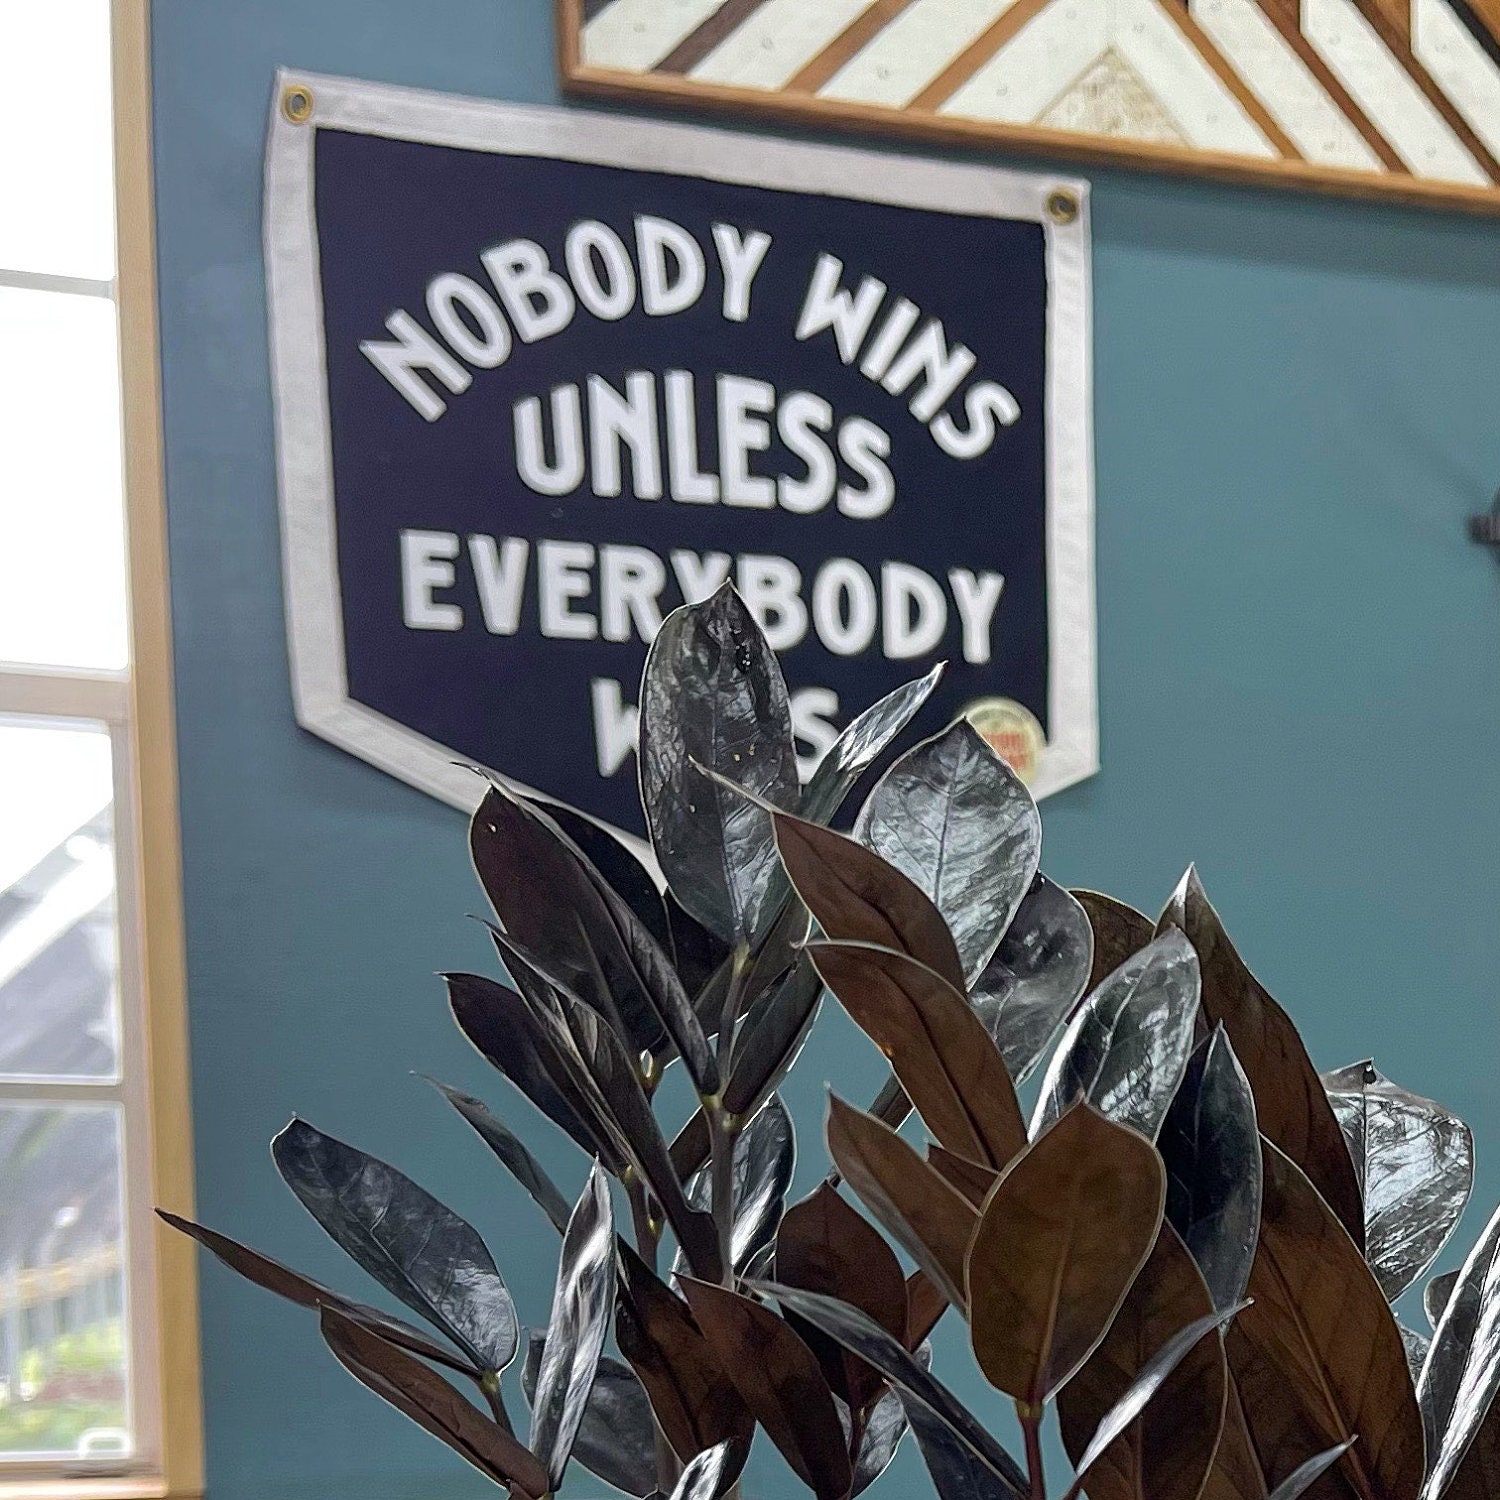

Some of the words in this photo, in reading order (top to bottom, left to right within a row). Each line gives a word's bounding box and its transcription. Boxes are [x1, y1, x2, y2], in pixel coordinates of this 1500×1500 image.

[359, 214, 772, 422] NOBODY
[795, 253, 1021, 459] WINS
[512, 369, 895, 519] UNLESS
[400, 528, 1005, 664] EVERYBODY
